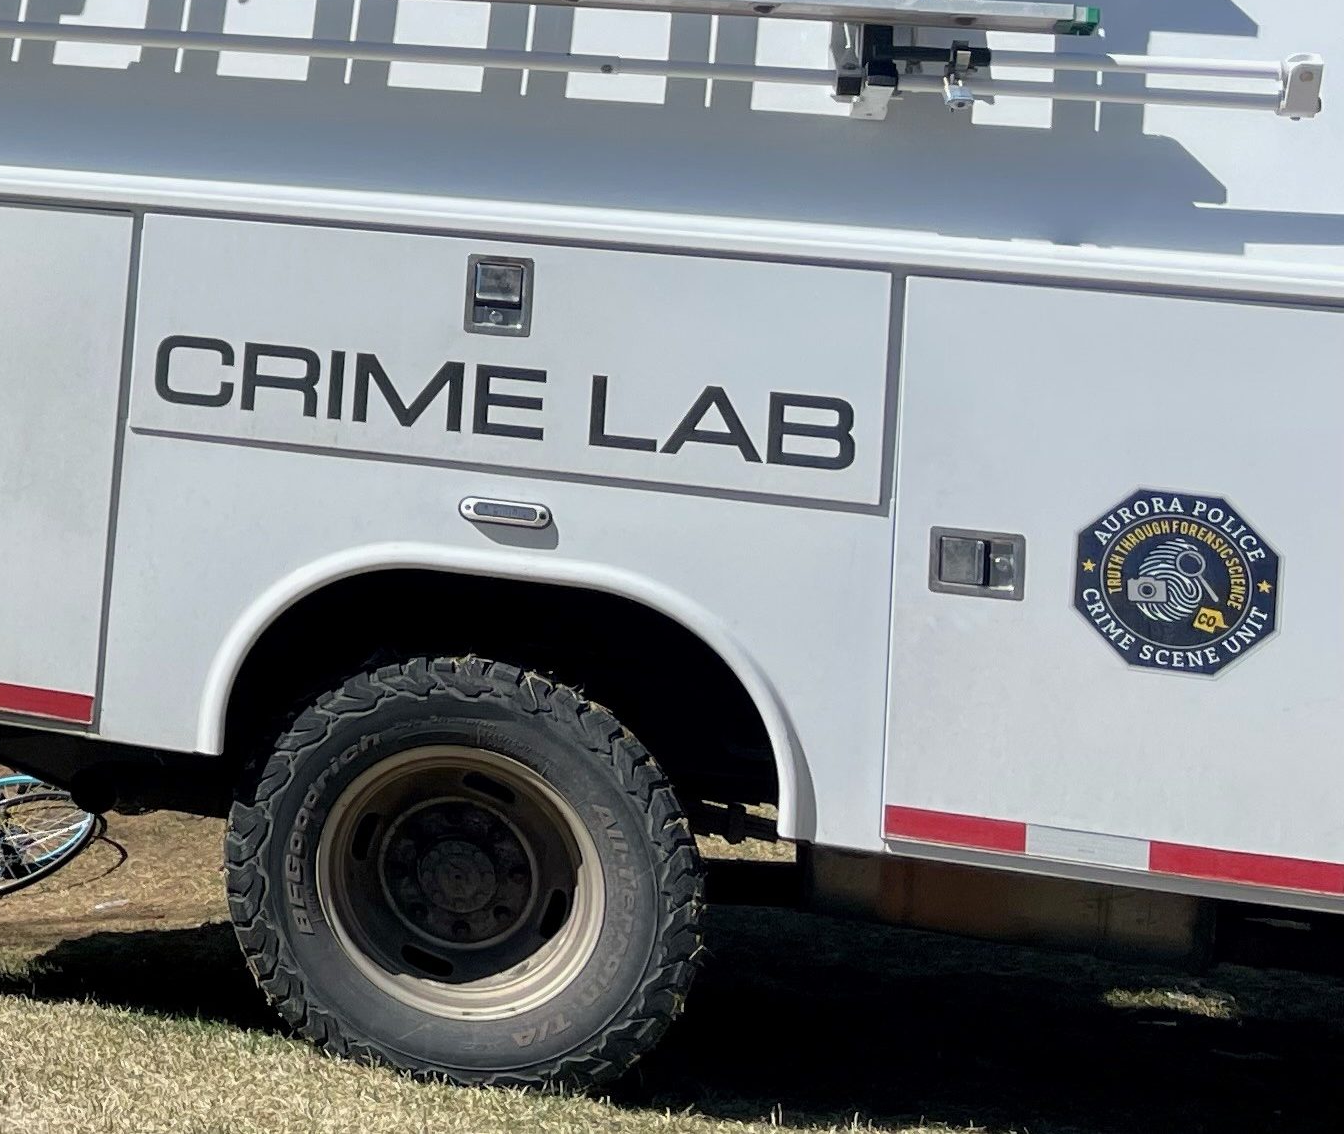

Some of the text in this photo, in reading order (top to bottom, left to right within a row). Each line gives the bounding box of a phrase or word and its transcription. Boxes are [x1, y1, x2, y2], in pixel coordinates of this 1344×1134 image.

[155, 335, 855, 470] CRIME LAB
[1094, 497, 1266, 563] AURORA POLICE
[1108, 521, 1247, 611] TRUTH THROUGH FORENSIC SCIENCE
[1082, 588, 1269, 668] CRIME SCENE UNIT
[1197, 613, 1217, 627] CO
[285, 732, 382, 935] BFGoodrich
